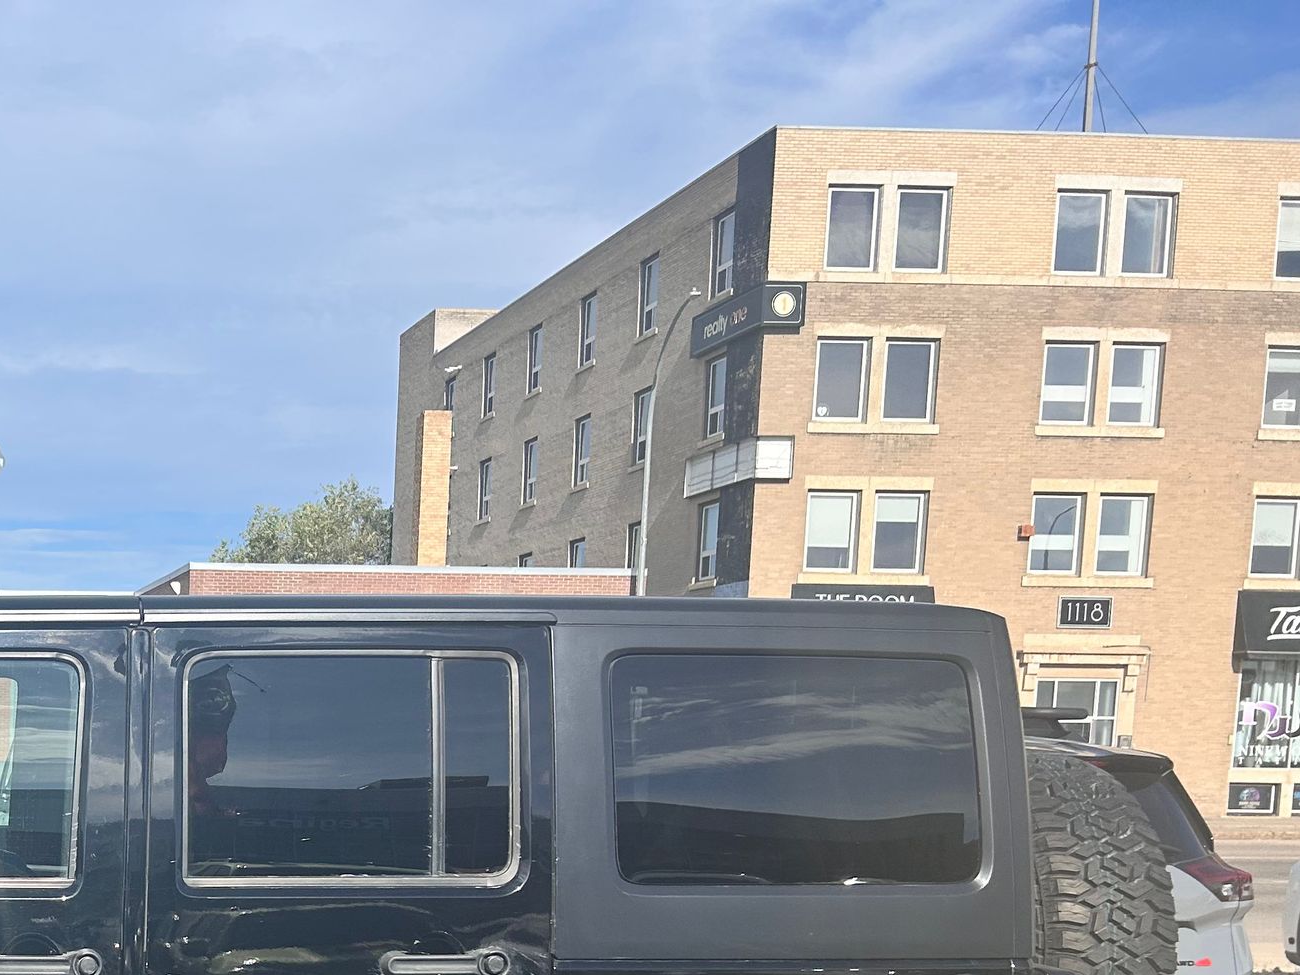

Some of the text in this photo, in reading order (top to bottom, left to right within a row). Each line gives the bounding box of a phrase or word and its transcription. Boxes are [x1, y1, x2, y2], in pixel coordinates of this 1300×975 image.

[703, 306, 748, 340] realty one
[1068, 602, 1104, 622] 1118
